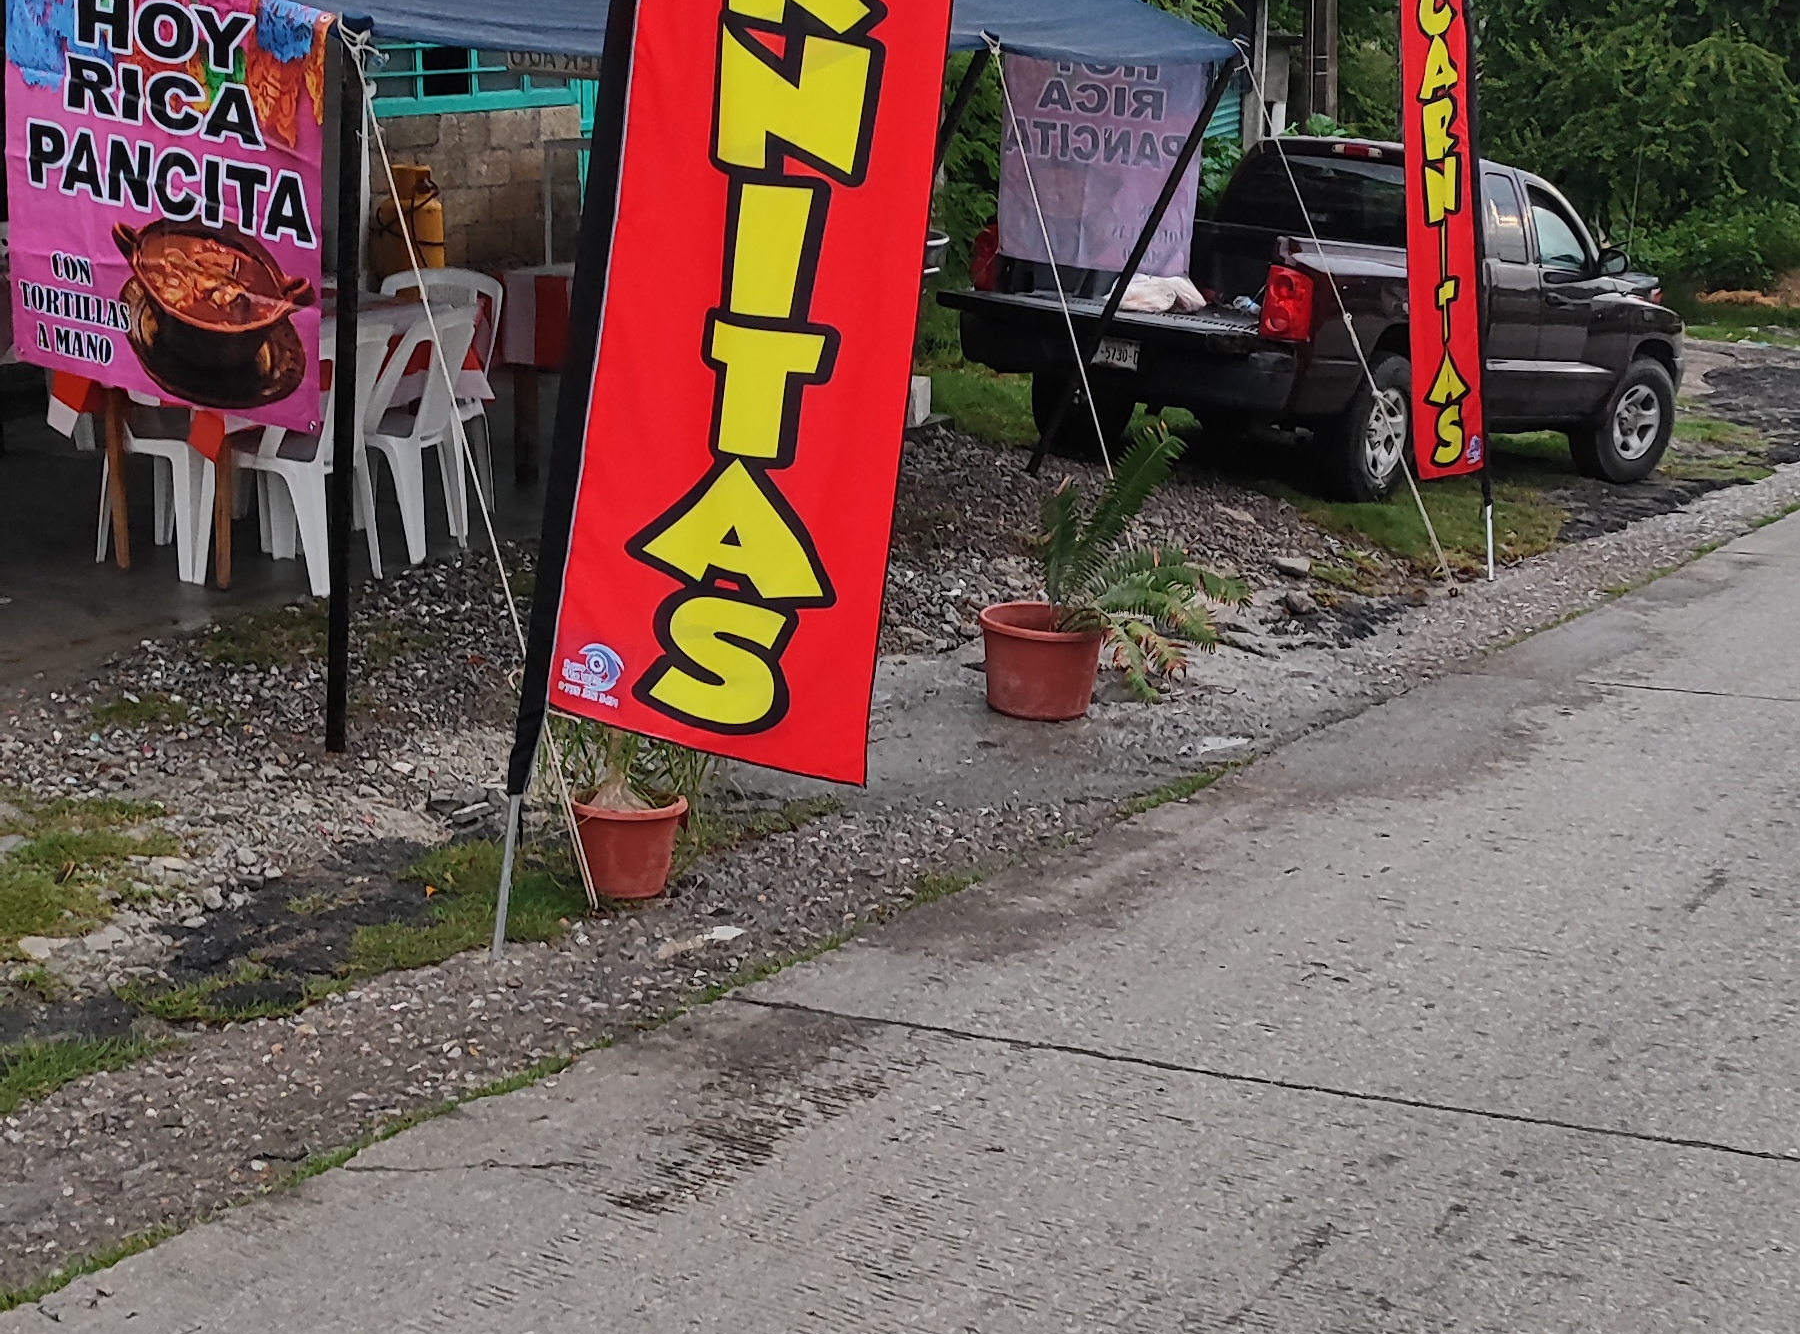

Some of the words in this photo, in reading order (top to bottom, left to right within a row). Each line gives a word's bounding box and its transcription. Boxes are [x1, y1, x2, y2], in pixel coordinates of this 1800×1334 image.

[63, 51, 267, 152] RICA
[25, 117, 318, 250] PANCITA
[50, 249, 93, 288] CON
[18, 277, 132, 333] TORTILLAS
[36, 320, 52, 353] A
[52, 324, 114, 367] MANO
